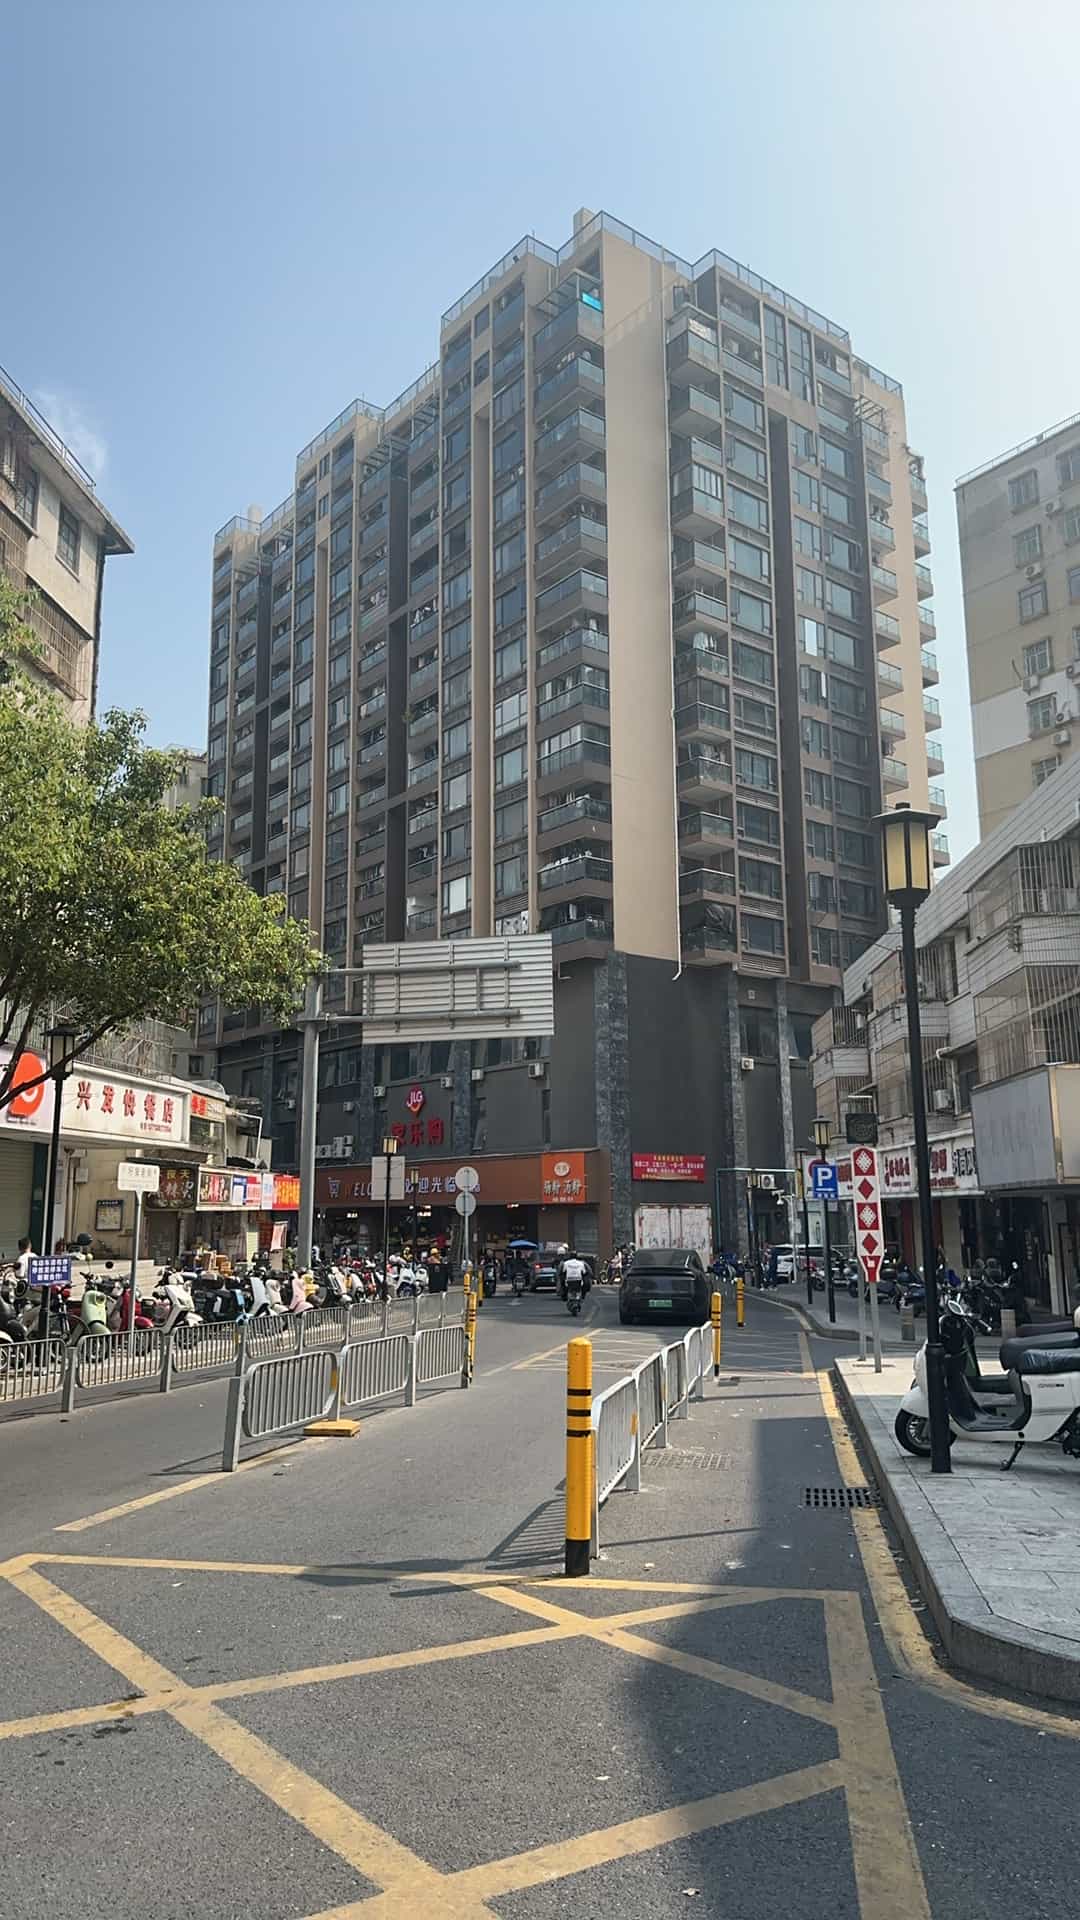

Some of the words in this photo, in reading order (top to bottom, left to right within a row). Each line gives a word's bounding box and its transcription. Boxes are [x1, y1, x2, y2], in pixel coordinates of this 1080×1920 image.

[76, 1081, 173, 1123] 兴发快餐店
[406, 1090, 423, 1107] JLG
[817, 1168, 832, 1186] P
